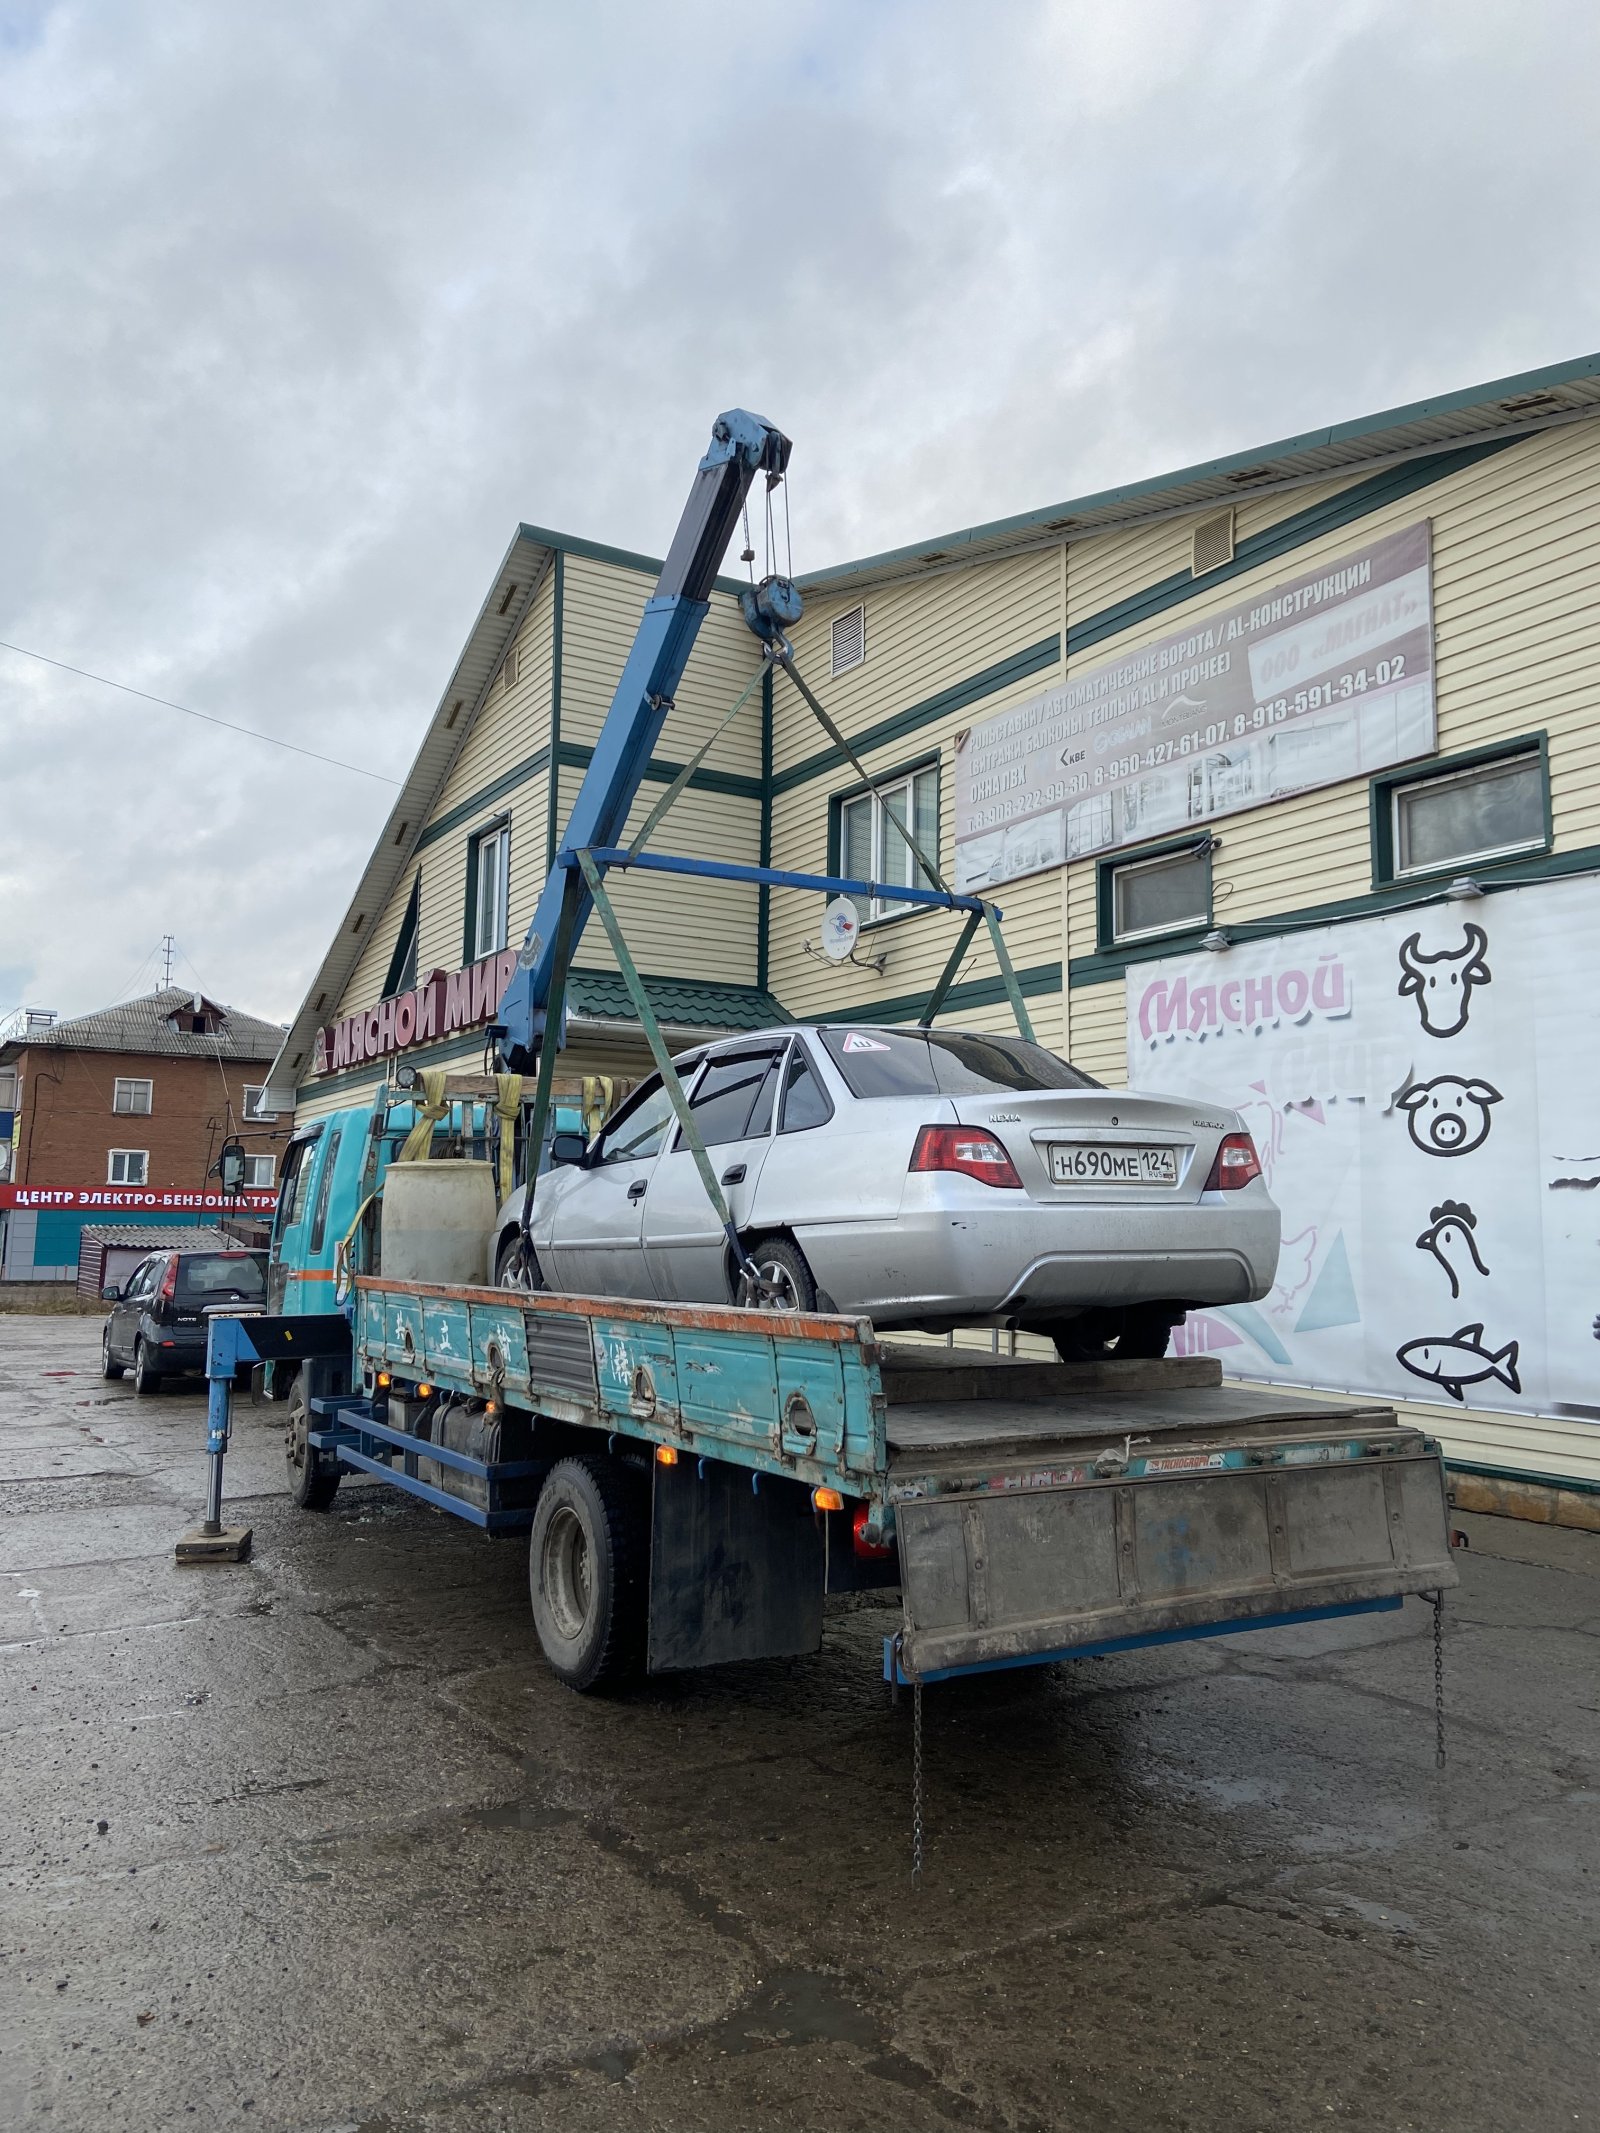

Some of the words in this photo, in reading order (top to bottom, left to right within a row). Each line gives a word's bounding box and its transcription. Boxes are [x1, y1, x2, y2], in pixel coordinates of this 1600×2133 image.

[969, 708, 1038, 753] РОЛЬСТАВНИ
[1046, 655, 1158, 719] АВТОМАТИЧЕСКИЕ
[1160, 628, 1215, 668] ВОРОТА
[1227, 559, 1372, 642] AL-КОНСТРУКЦИИ
[1027, 719, 1087, 753] БАЛКОНЫ,
[1087, 695, 1140, 728] ТЕПЛЫЙ
[1160, 678, 1170, 697] И
[1094, 719, 1230, 787] 8-950-427-61-07,
[1233, 654, 1406, 738] 8-913-591-34-02
[1069, 750, 1086, 765] KBE
[970, 775, 1000, 805] ОКНА
[1002, 765, 1027, 795] ПВХ
[332, 968, 446, 1069] МЯСНОЙ
[444, 949, 520, 1032] МИР
[989, 1113, 1022, 1122] NEXIA
[1061, 1150, 1139, 1177] Н690МЕ
[1141, 1151, 1170, 1171] 124
[1148, 1170, 1163, 1178] RUS
[16, 1190, 75, 1206] ЦЕНТР
